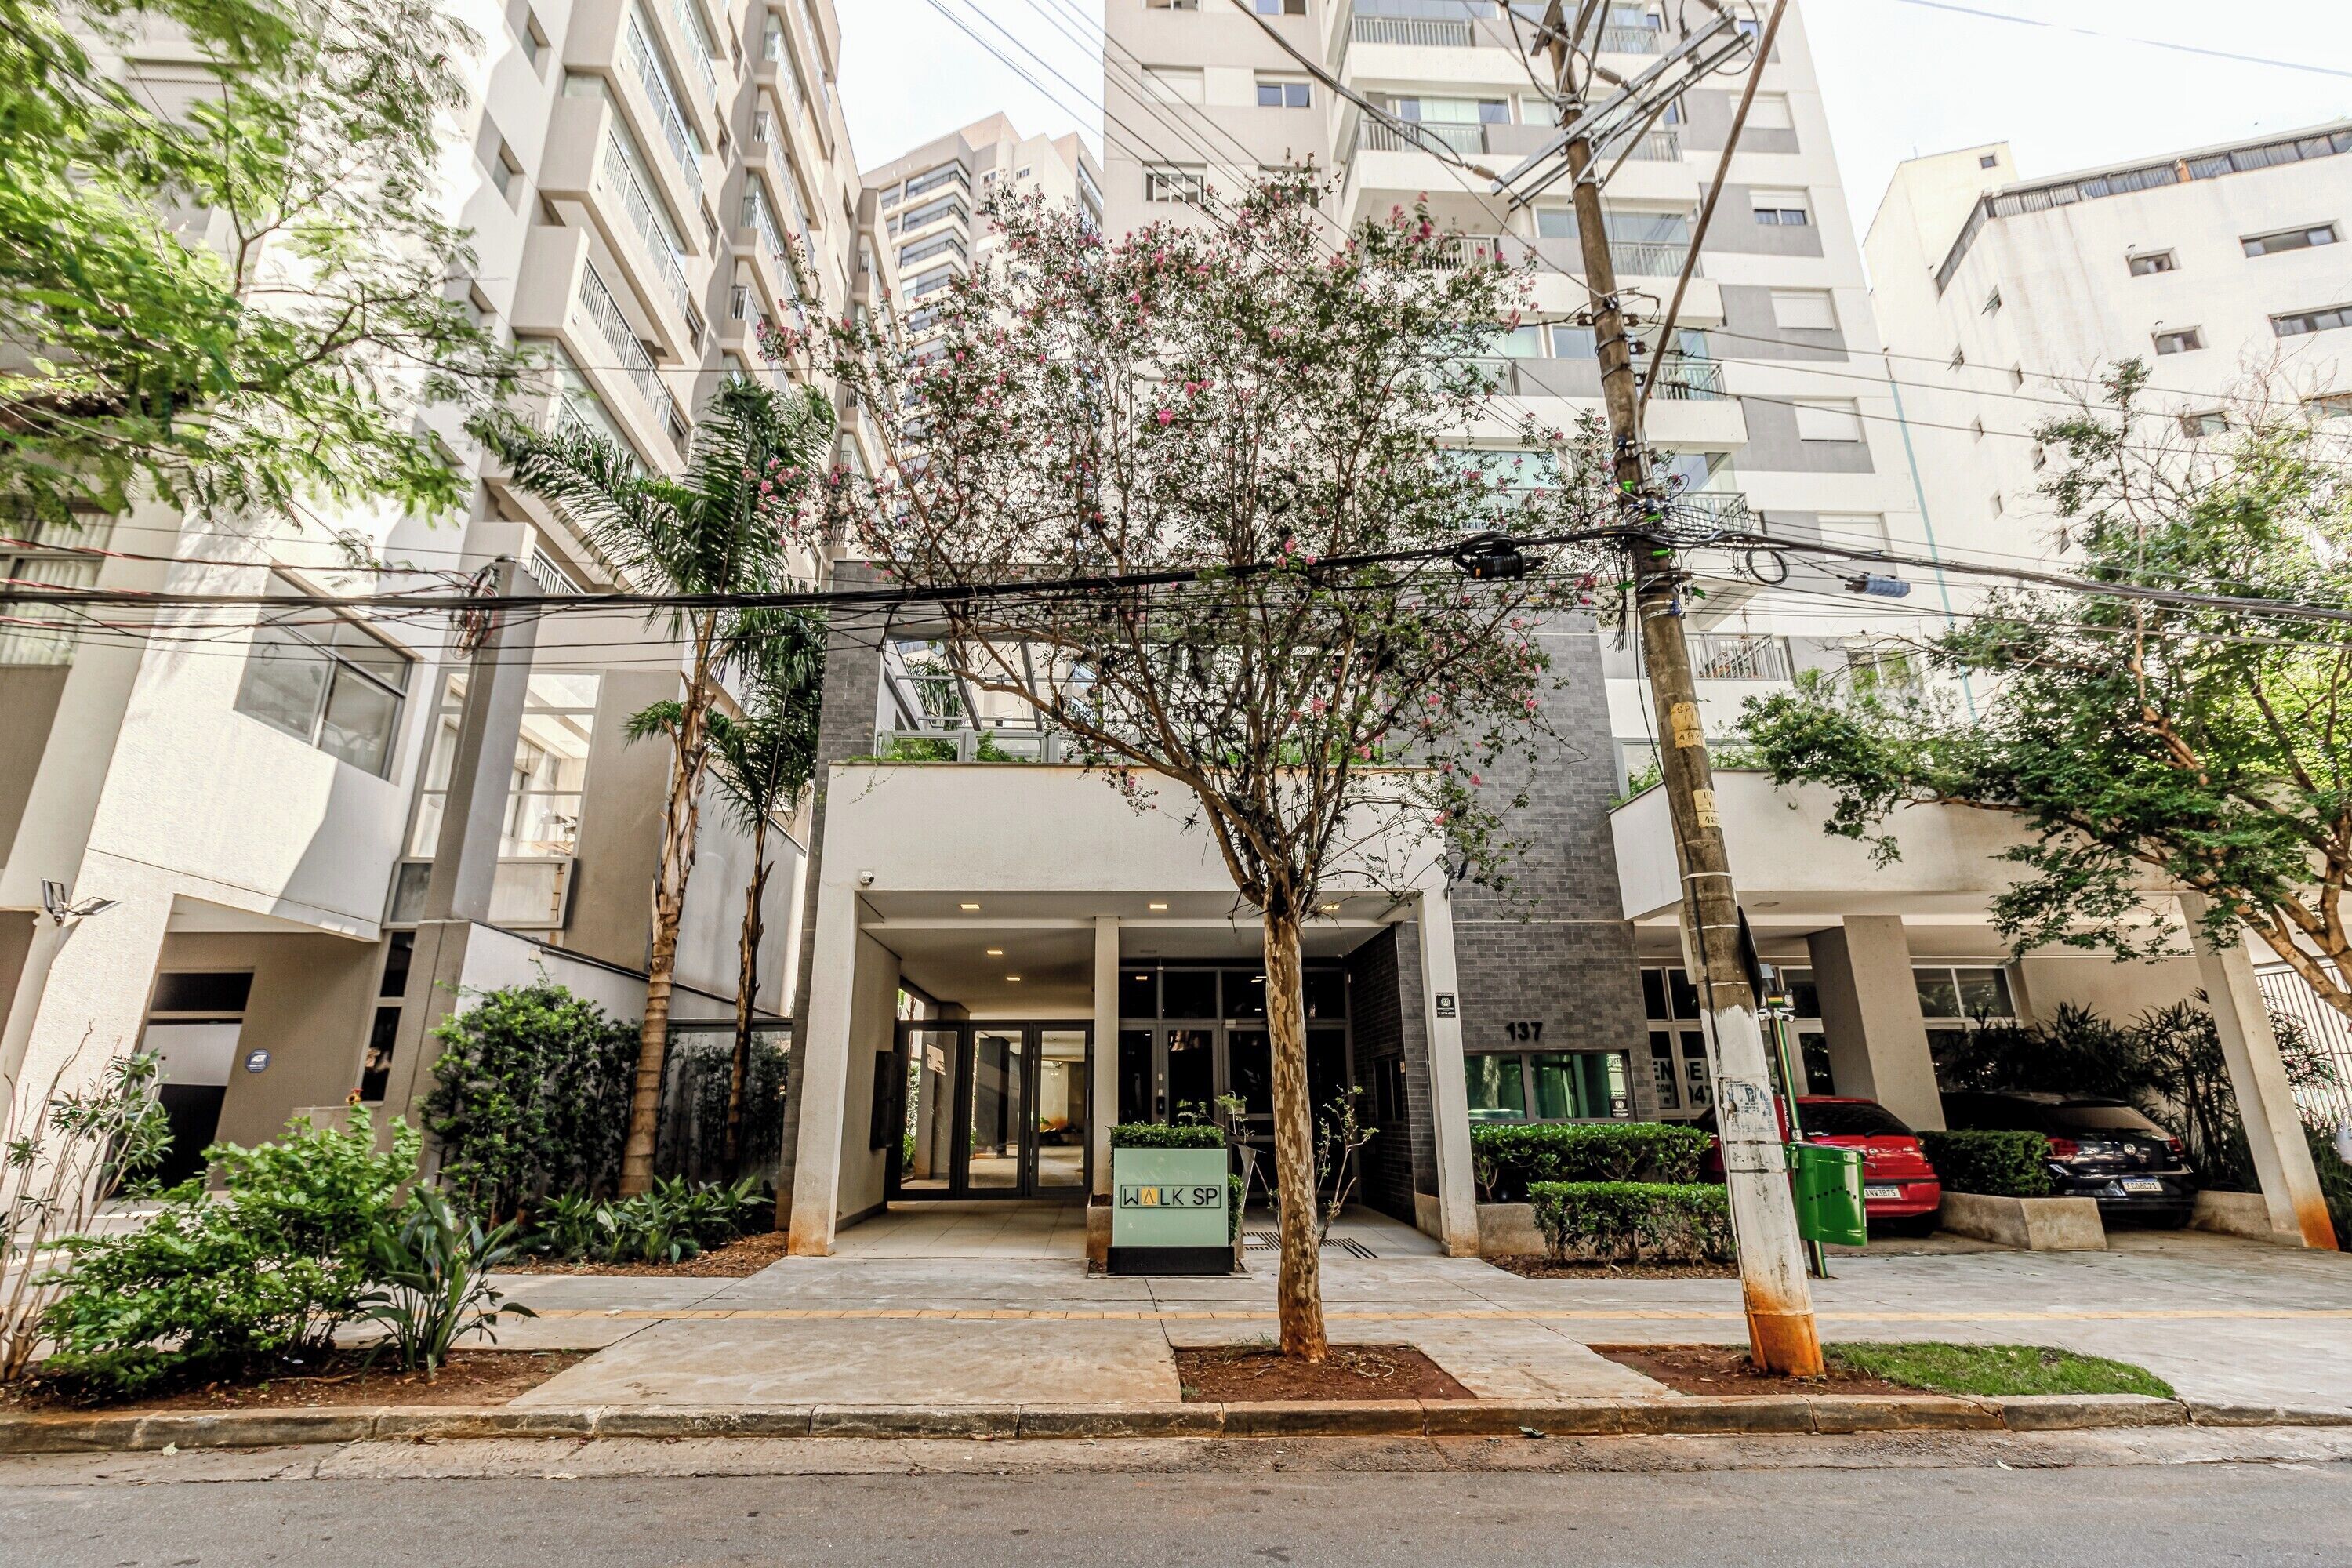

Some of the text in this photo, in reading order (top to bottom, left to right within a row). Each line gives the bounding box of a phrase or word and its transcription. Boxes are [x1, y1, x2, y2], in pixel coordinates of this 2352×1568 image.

[1506, 1022, 1543, 1041] 137
[1124, 1188, 1218, 1205] WALK SP
